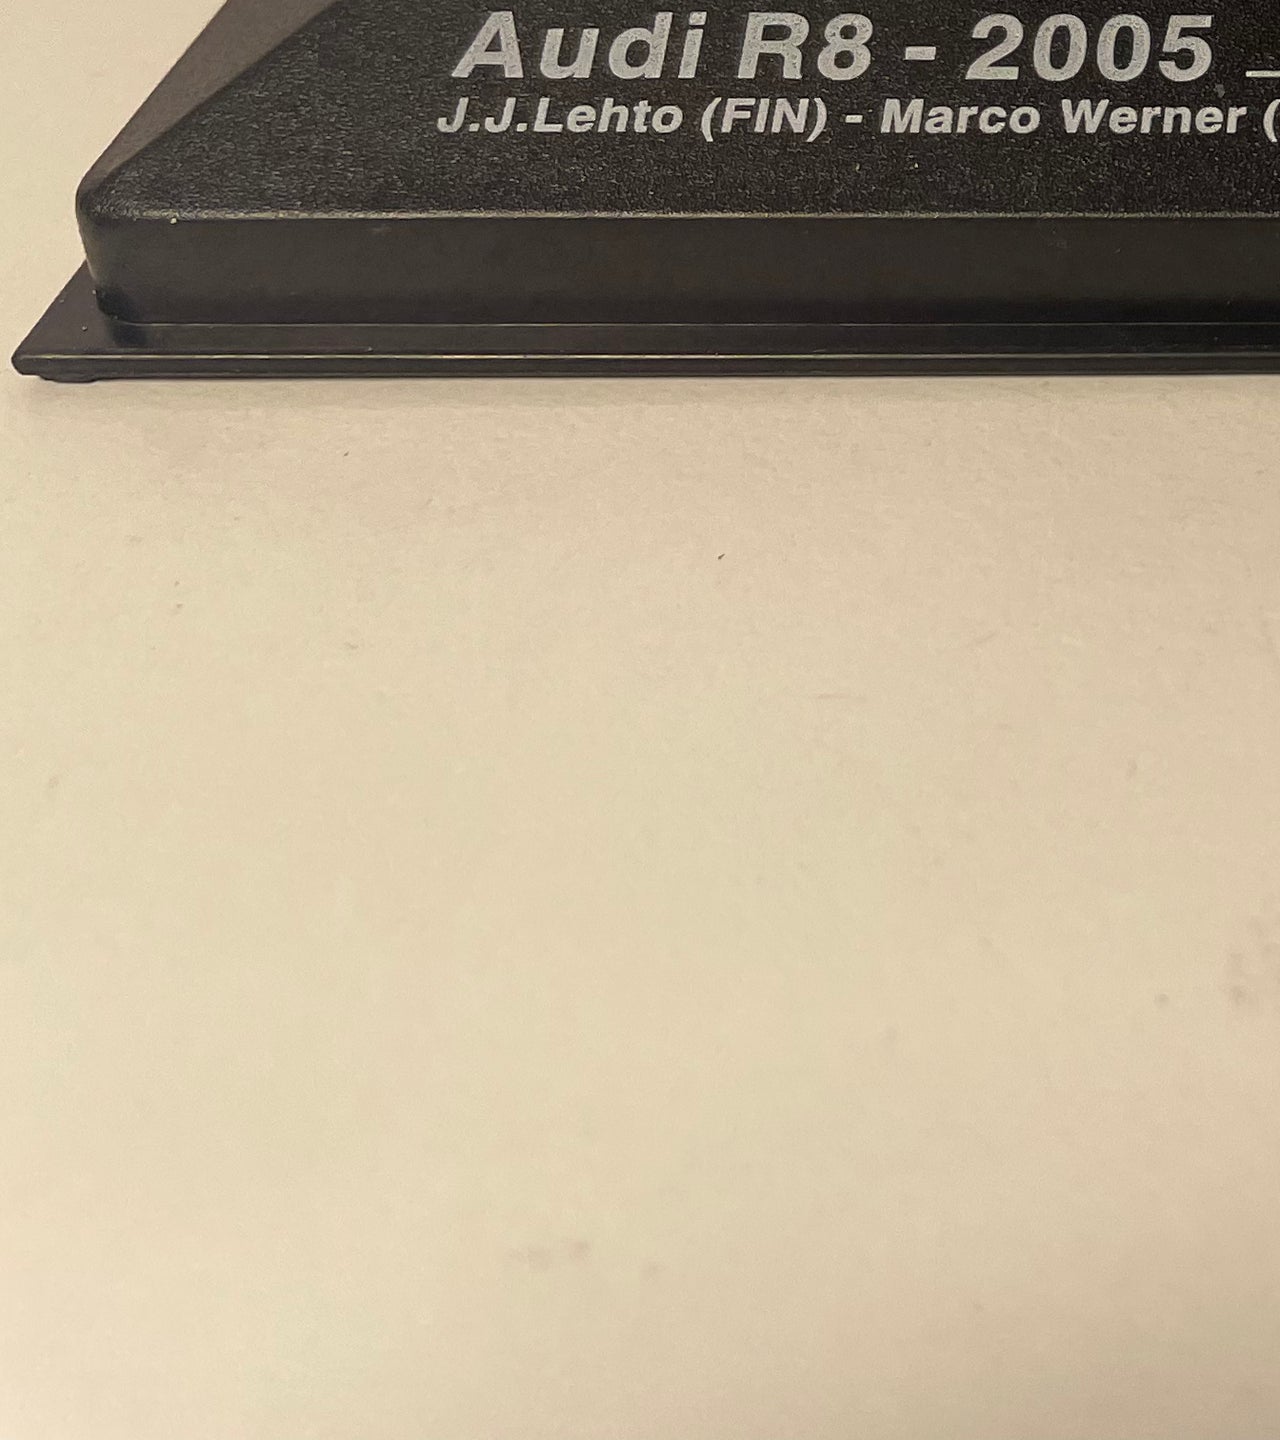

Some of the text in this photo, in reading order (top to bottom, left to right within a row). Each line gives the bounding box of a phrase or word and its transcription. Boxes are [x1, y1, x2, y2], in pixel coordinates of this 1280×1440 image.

[451, 10, 708, 81] Audi
[737, 11, 874, 81] R8
[964, 13, 1215, 82] 2005
[436, 98, 683, 135] J.J.Lehto
[701, 96, 827, 142] (FIN)
[879, 98, 1041, 135] Marco
[1058, 98, 1248, 135] Werner
